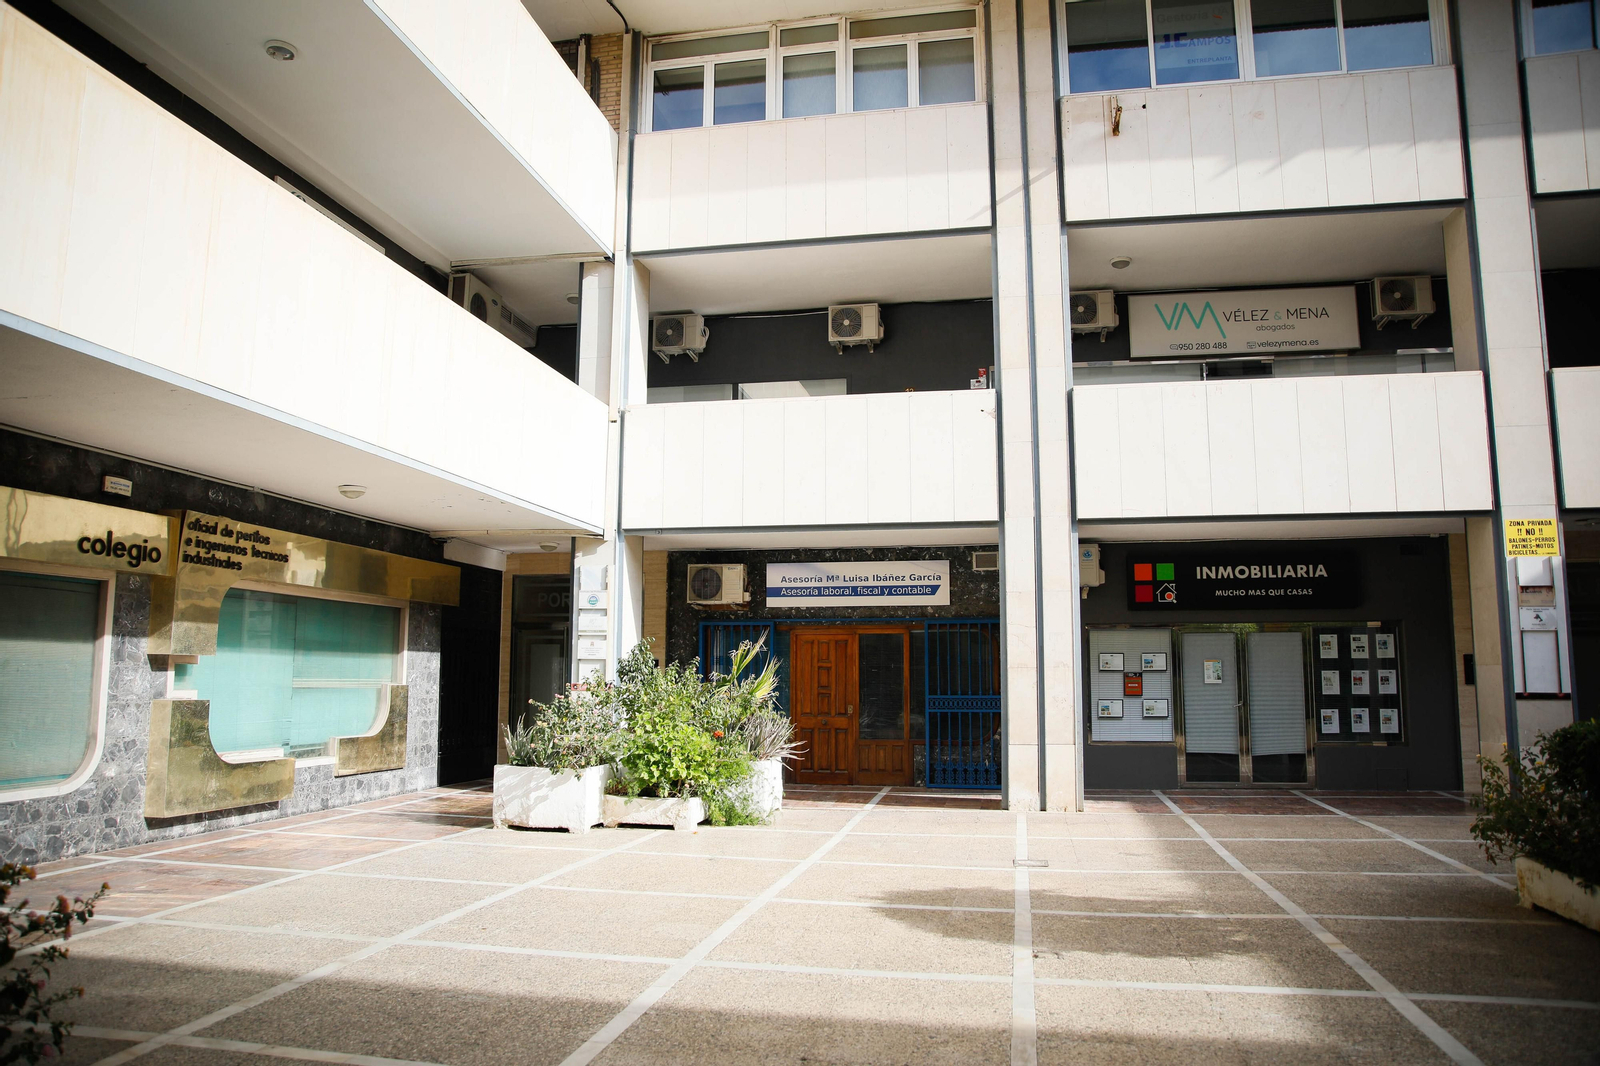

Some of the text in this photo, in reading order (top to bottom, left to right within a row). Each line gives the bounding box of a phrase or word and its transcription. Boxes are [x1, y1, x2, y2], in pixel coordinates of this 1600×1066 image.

[1187, 56, 1232, 64] ENTREPLANTA
[1223, 308, 1330, 322] VÉLEZ & MENA
[1256, 323, 1296, 332] abogados
[1178, 343, 1194, 351] 950
[1213, 342, 1228, 350] 488
[1257, 339, 1319, 349] velezymena.es
[187, 518, 271, 545] oficial de peritos
[1526, 528, 1535, 536] NO
[77, 531, 161, 568] colegio
[184, 537, 192, 546] e
[195, 536, 248, 556] ingenieros
[182, 551, 243, 571] industriales
[1196, 564, 1328, 579] INMOBILIARIA
[781, 575, 822, 583] Asesoría
[843, 574, 869, 582] Luisa
[872, 573, 906, 582] Ibáñez
[909, 573, 942, 581] García
[781, 585, 931, 596] Asesoría laboral, fiscal y contable
